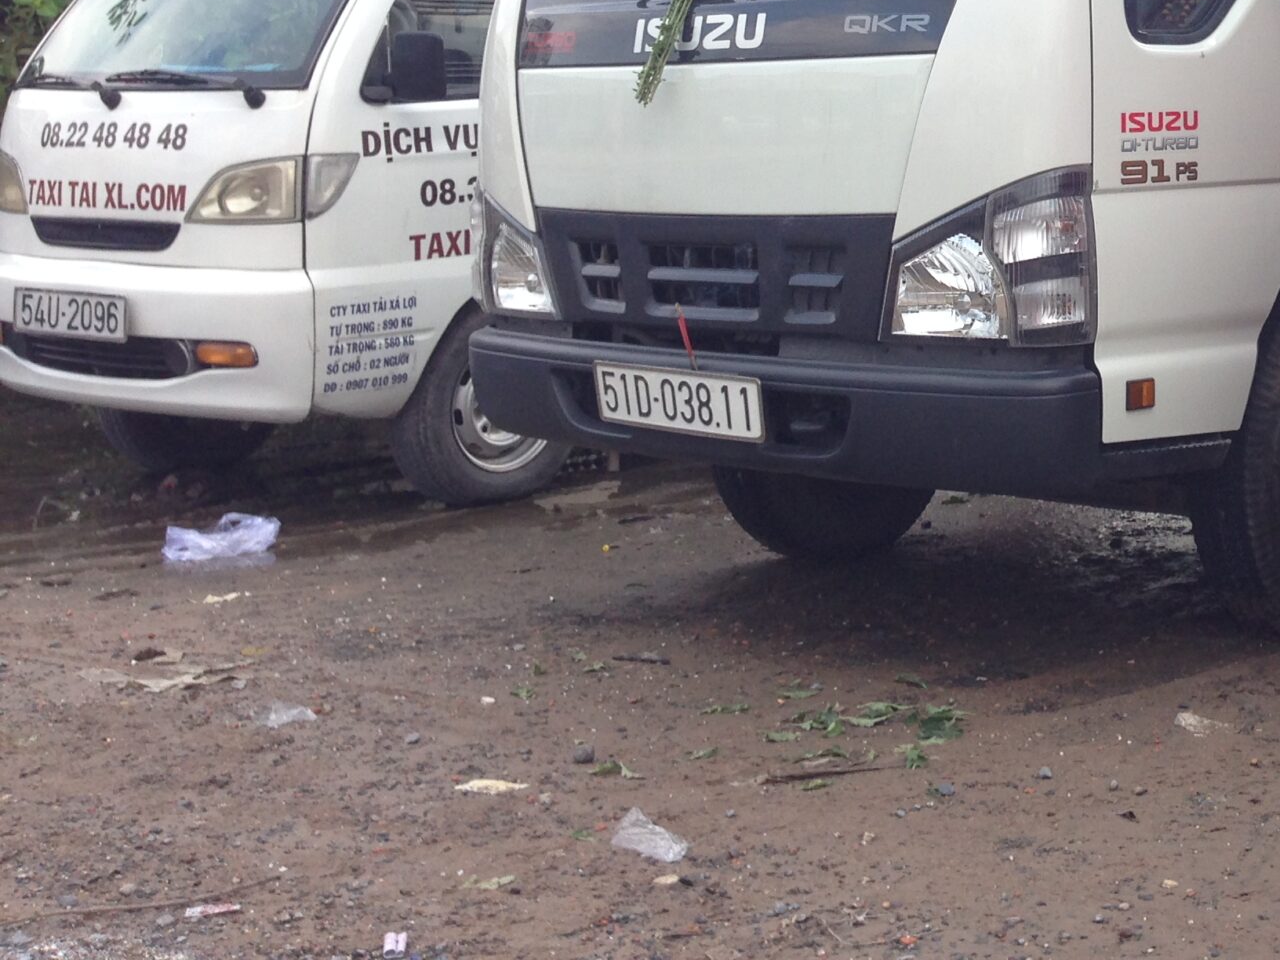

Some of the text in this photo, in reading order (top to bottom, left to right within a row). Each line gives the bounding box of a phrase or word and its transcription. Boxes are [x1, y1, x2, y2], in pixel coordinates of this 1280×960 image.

[633, 12, 767, 54] ISUZU
[844, 14, 930, 34] QKR
[1121, 110, 1198, 133] ISUZU
[41, 122, 188, 151] 08.22 48 48 48
[442, 123, 479, 157] VỤ
[1120, 159, 1198, 185] 91 PS
[29, 179, 187, 212] TAXI TAI XL.COM
[409, 229, 471, 261] TAXI
[329, 304, 348, 318] CTY
[350, 301, 370, 315] TAXI
[401, 316, 413, 329] KG
[402, 334, 415, 347] KG
[369, 358, 382, 370] 02
[371, 375, 390, 388] 010
[601, 370, 751, 432] 51D-038.11
